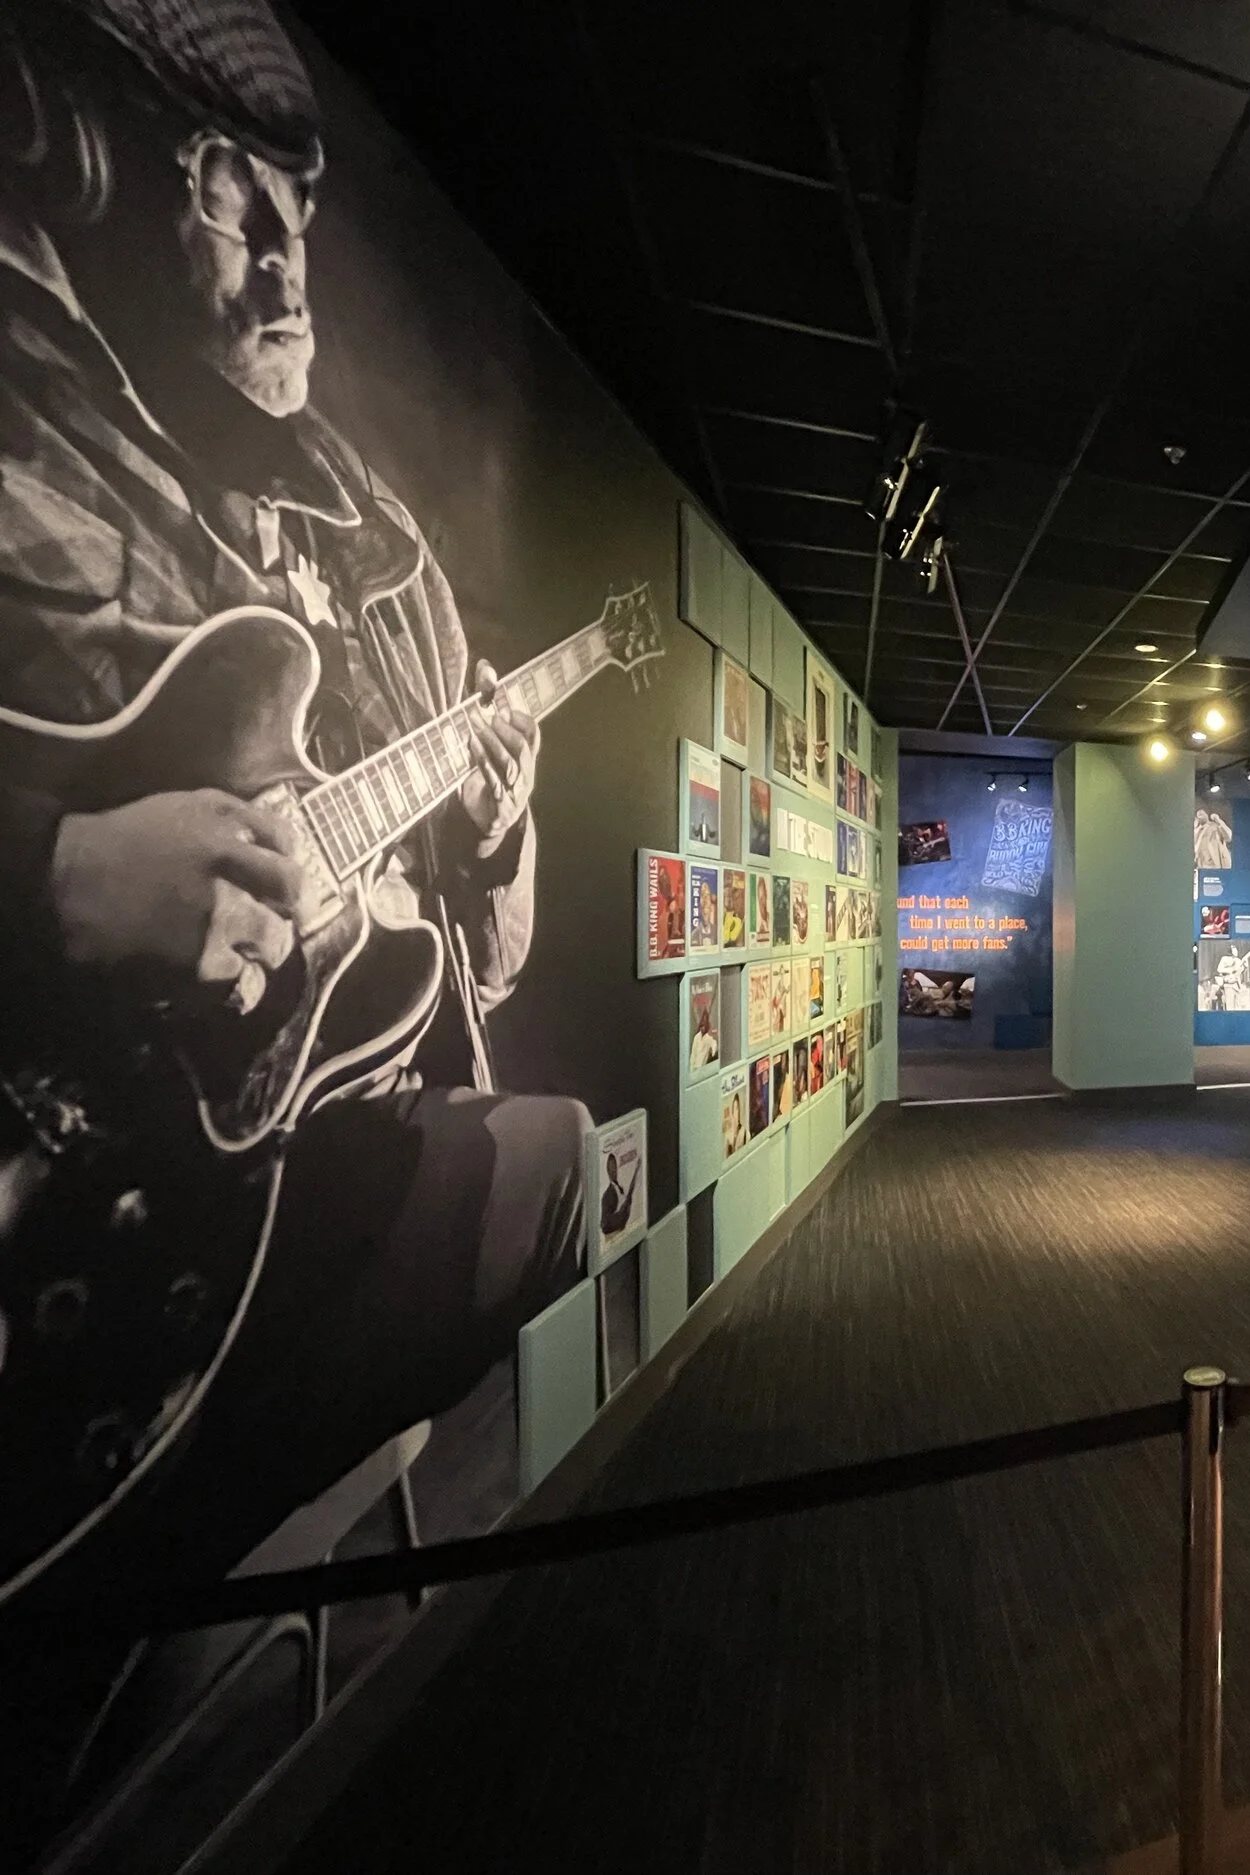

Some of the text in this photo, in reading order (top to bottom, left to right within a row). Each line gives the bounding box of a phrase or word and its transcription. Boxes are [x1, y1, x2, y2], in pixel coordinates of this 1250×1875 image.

[649, 859, 658, 898] WAILS
[919, 895, 941, 909] that
[944, 895, 969, 909] each
[649, 900, 658, 932] KING
[910, 915, 933, 929] time
[944, 915, 970, 929] went
[974, 915, 985, 929] to
[989, 919, 995, 929] a
[999, 915, 1028, 931] place,
[900, 936, 928, 950] could
[931, 936, 949, 951] get
[953, 939, 979, 949] more
